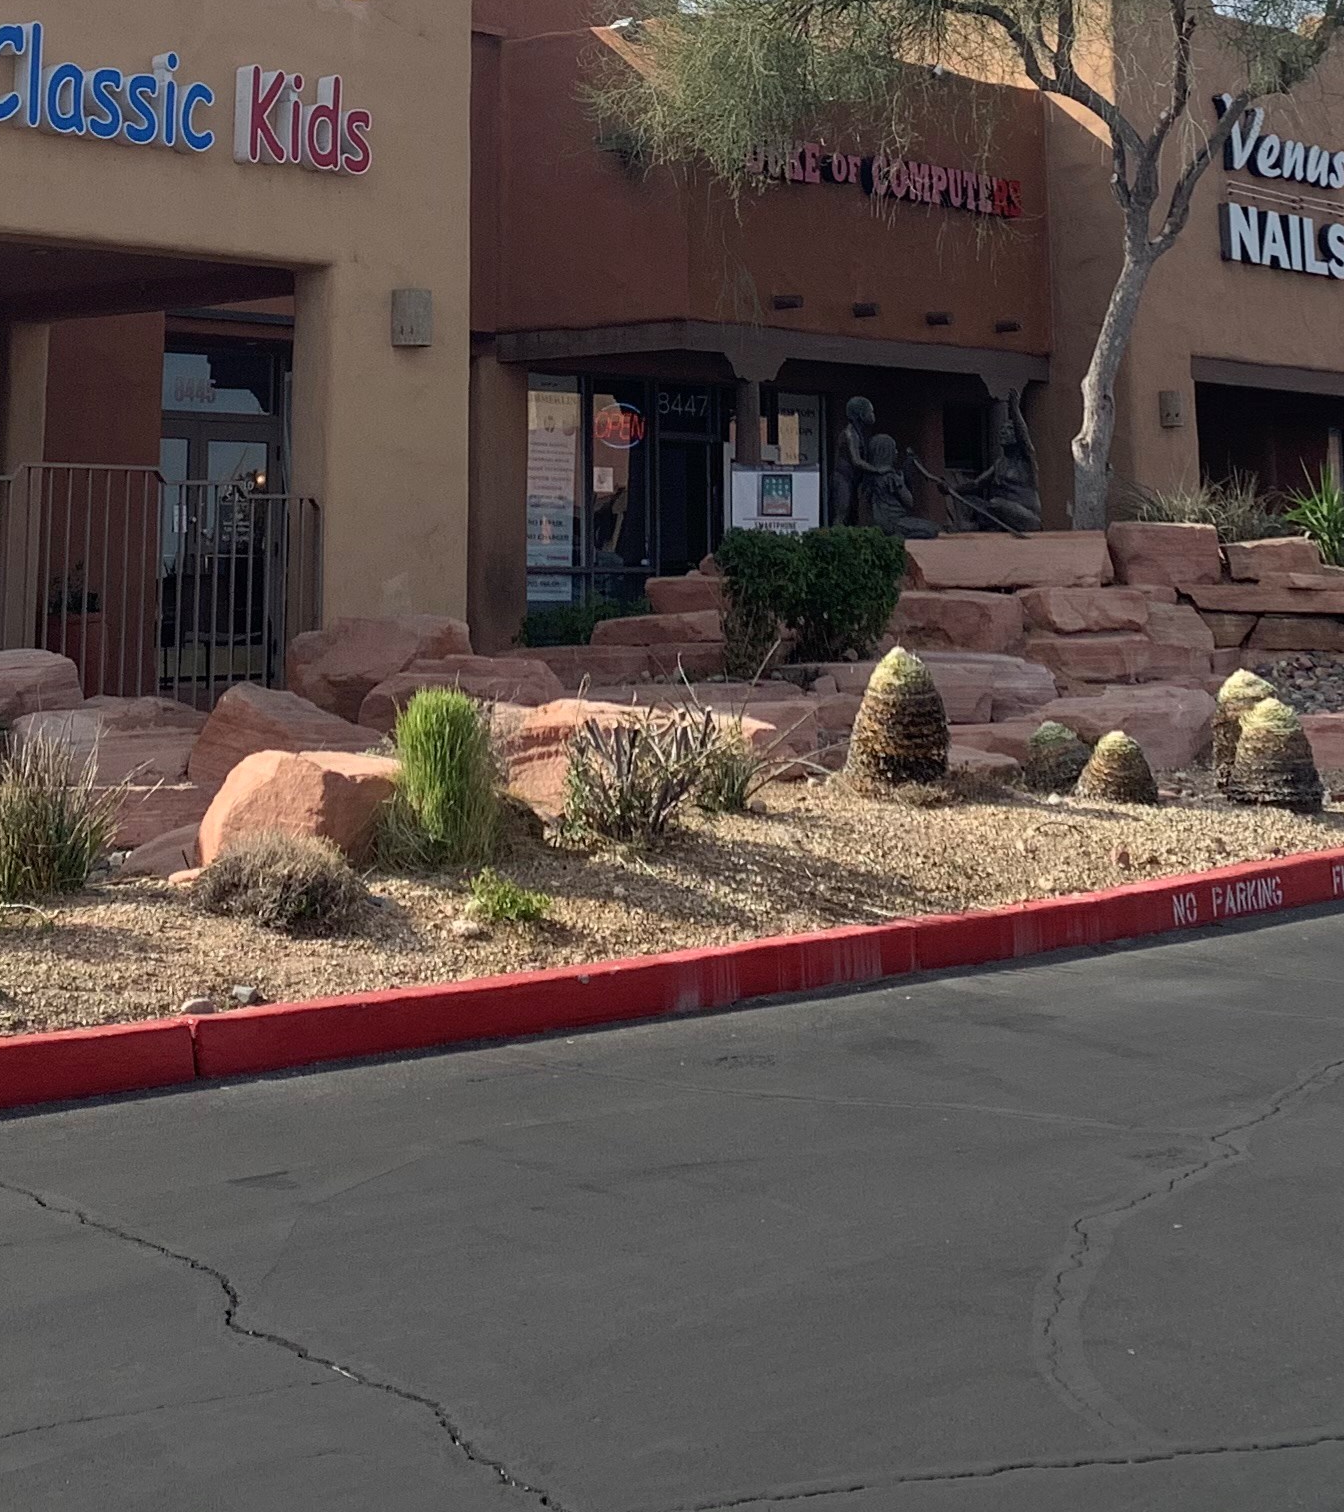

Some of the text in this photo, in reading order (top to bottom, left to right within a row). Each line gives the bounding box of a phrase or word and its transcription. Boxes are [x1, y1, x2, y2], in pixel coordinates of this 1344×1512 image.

[236, 65, 372, 175] Kids
[870, 154, 1023, 218] COMPUTERS
[595, 410, 646, 441] OPEN
[657, 392, 708, 417] 8447
[1172, 891, 1198, 926] NO
[1211, 876, 1283, 918] PARKING
